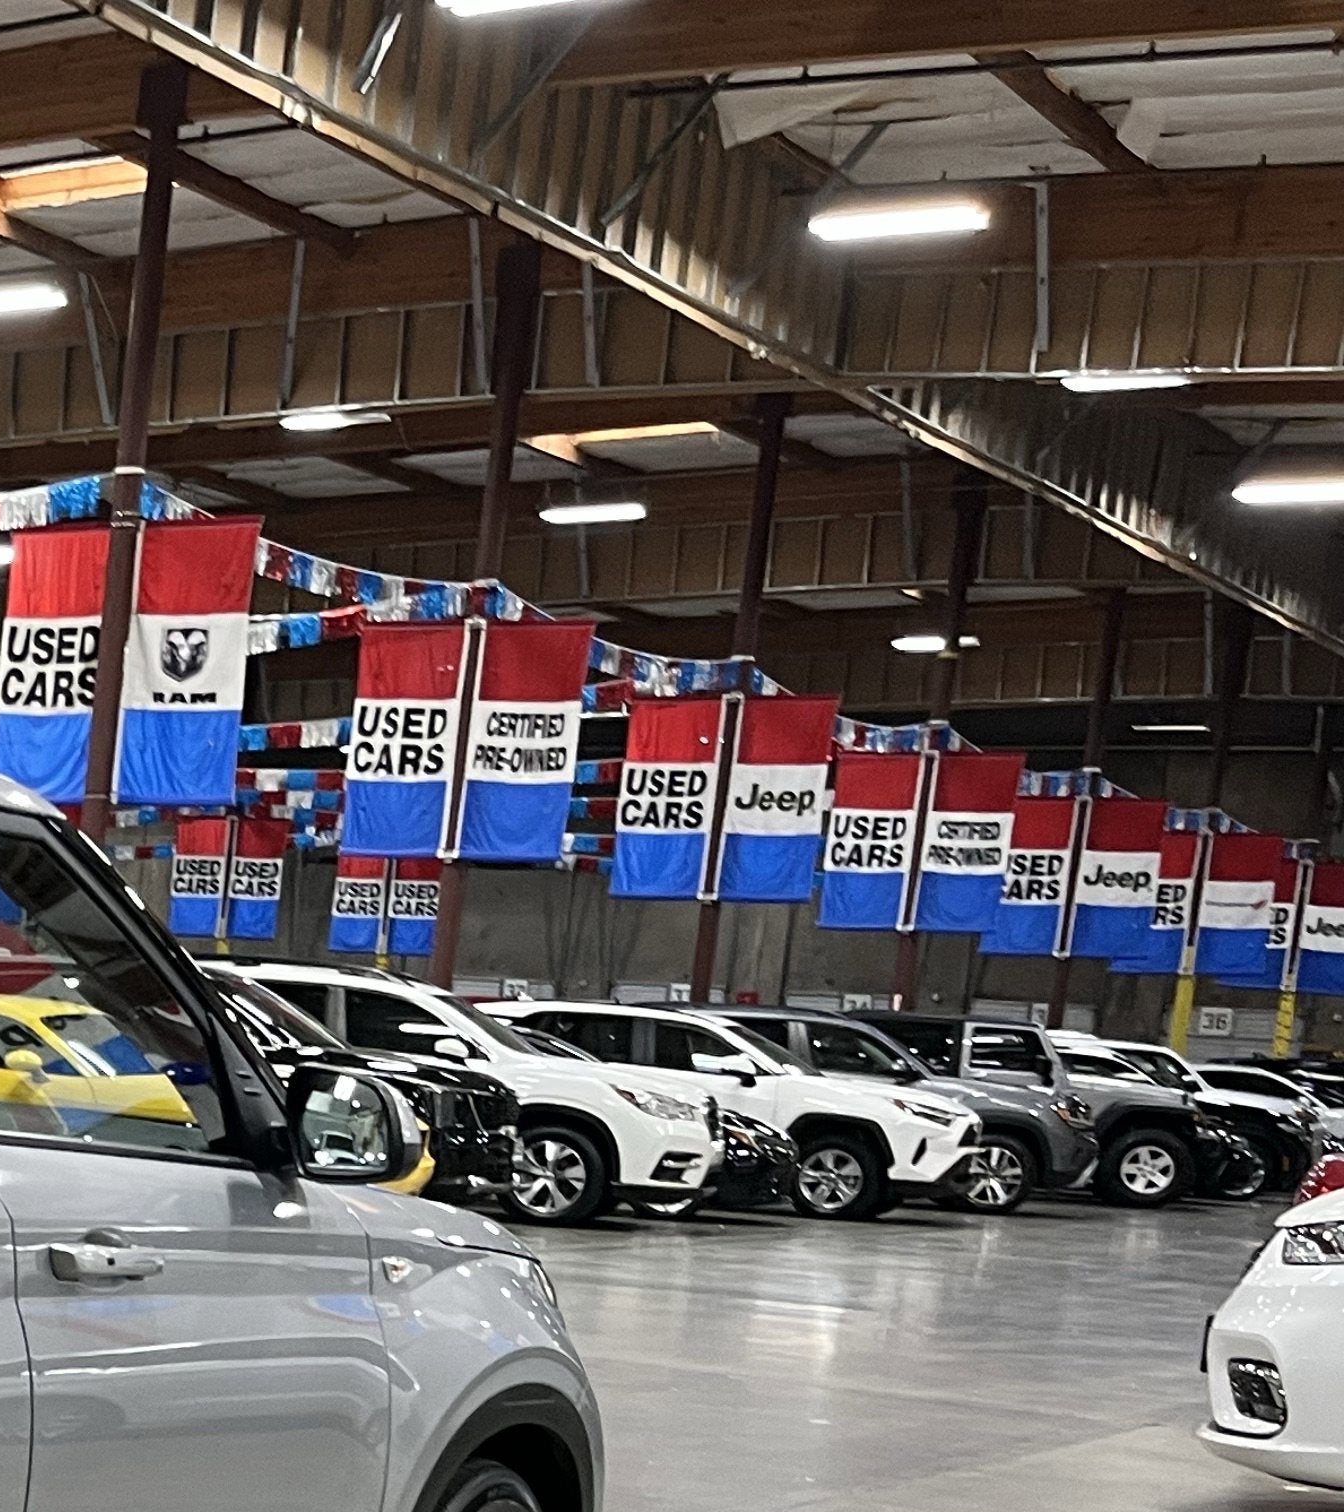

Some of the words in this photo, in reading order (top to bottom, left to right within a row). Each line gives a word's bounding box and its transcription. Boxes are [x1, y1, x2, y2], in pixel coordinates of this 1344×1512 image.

[7, 626, 101, 665] USED
[1, 667, 97, 707] CARS
[152, 692, 217, 704] RAM
[357, 706, 447, 739] USED
[353, 741, 445, 776] CARS
[626, 768, 708, 797] USED
[734, 783, 816, 816] Jeep
[621, 799, 704, 829] CARS
[833, 814, 907, 840] USED
[831, 842, 904, 867] CARS
[175, 859, 221, 877] USED
[1083, 864, 1151, 892] Jeep
[173, 878, 220, 896] CARS
[337, 881, 382, 898] USED
[393, 882, 438, 900] USED
[1006, 879, 1061, 900] ARS
[335, 899, 381, 916] CARS
[392, 900, 438, 918] CARS
